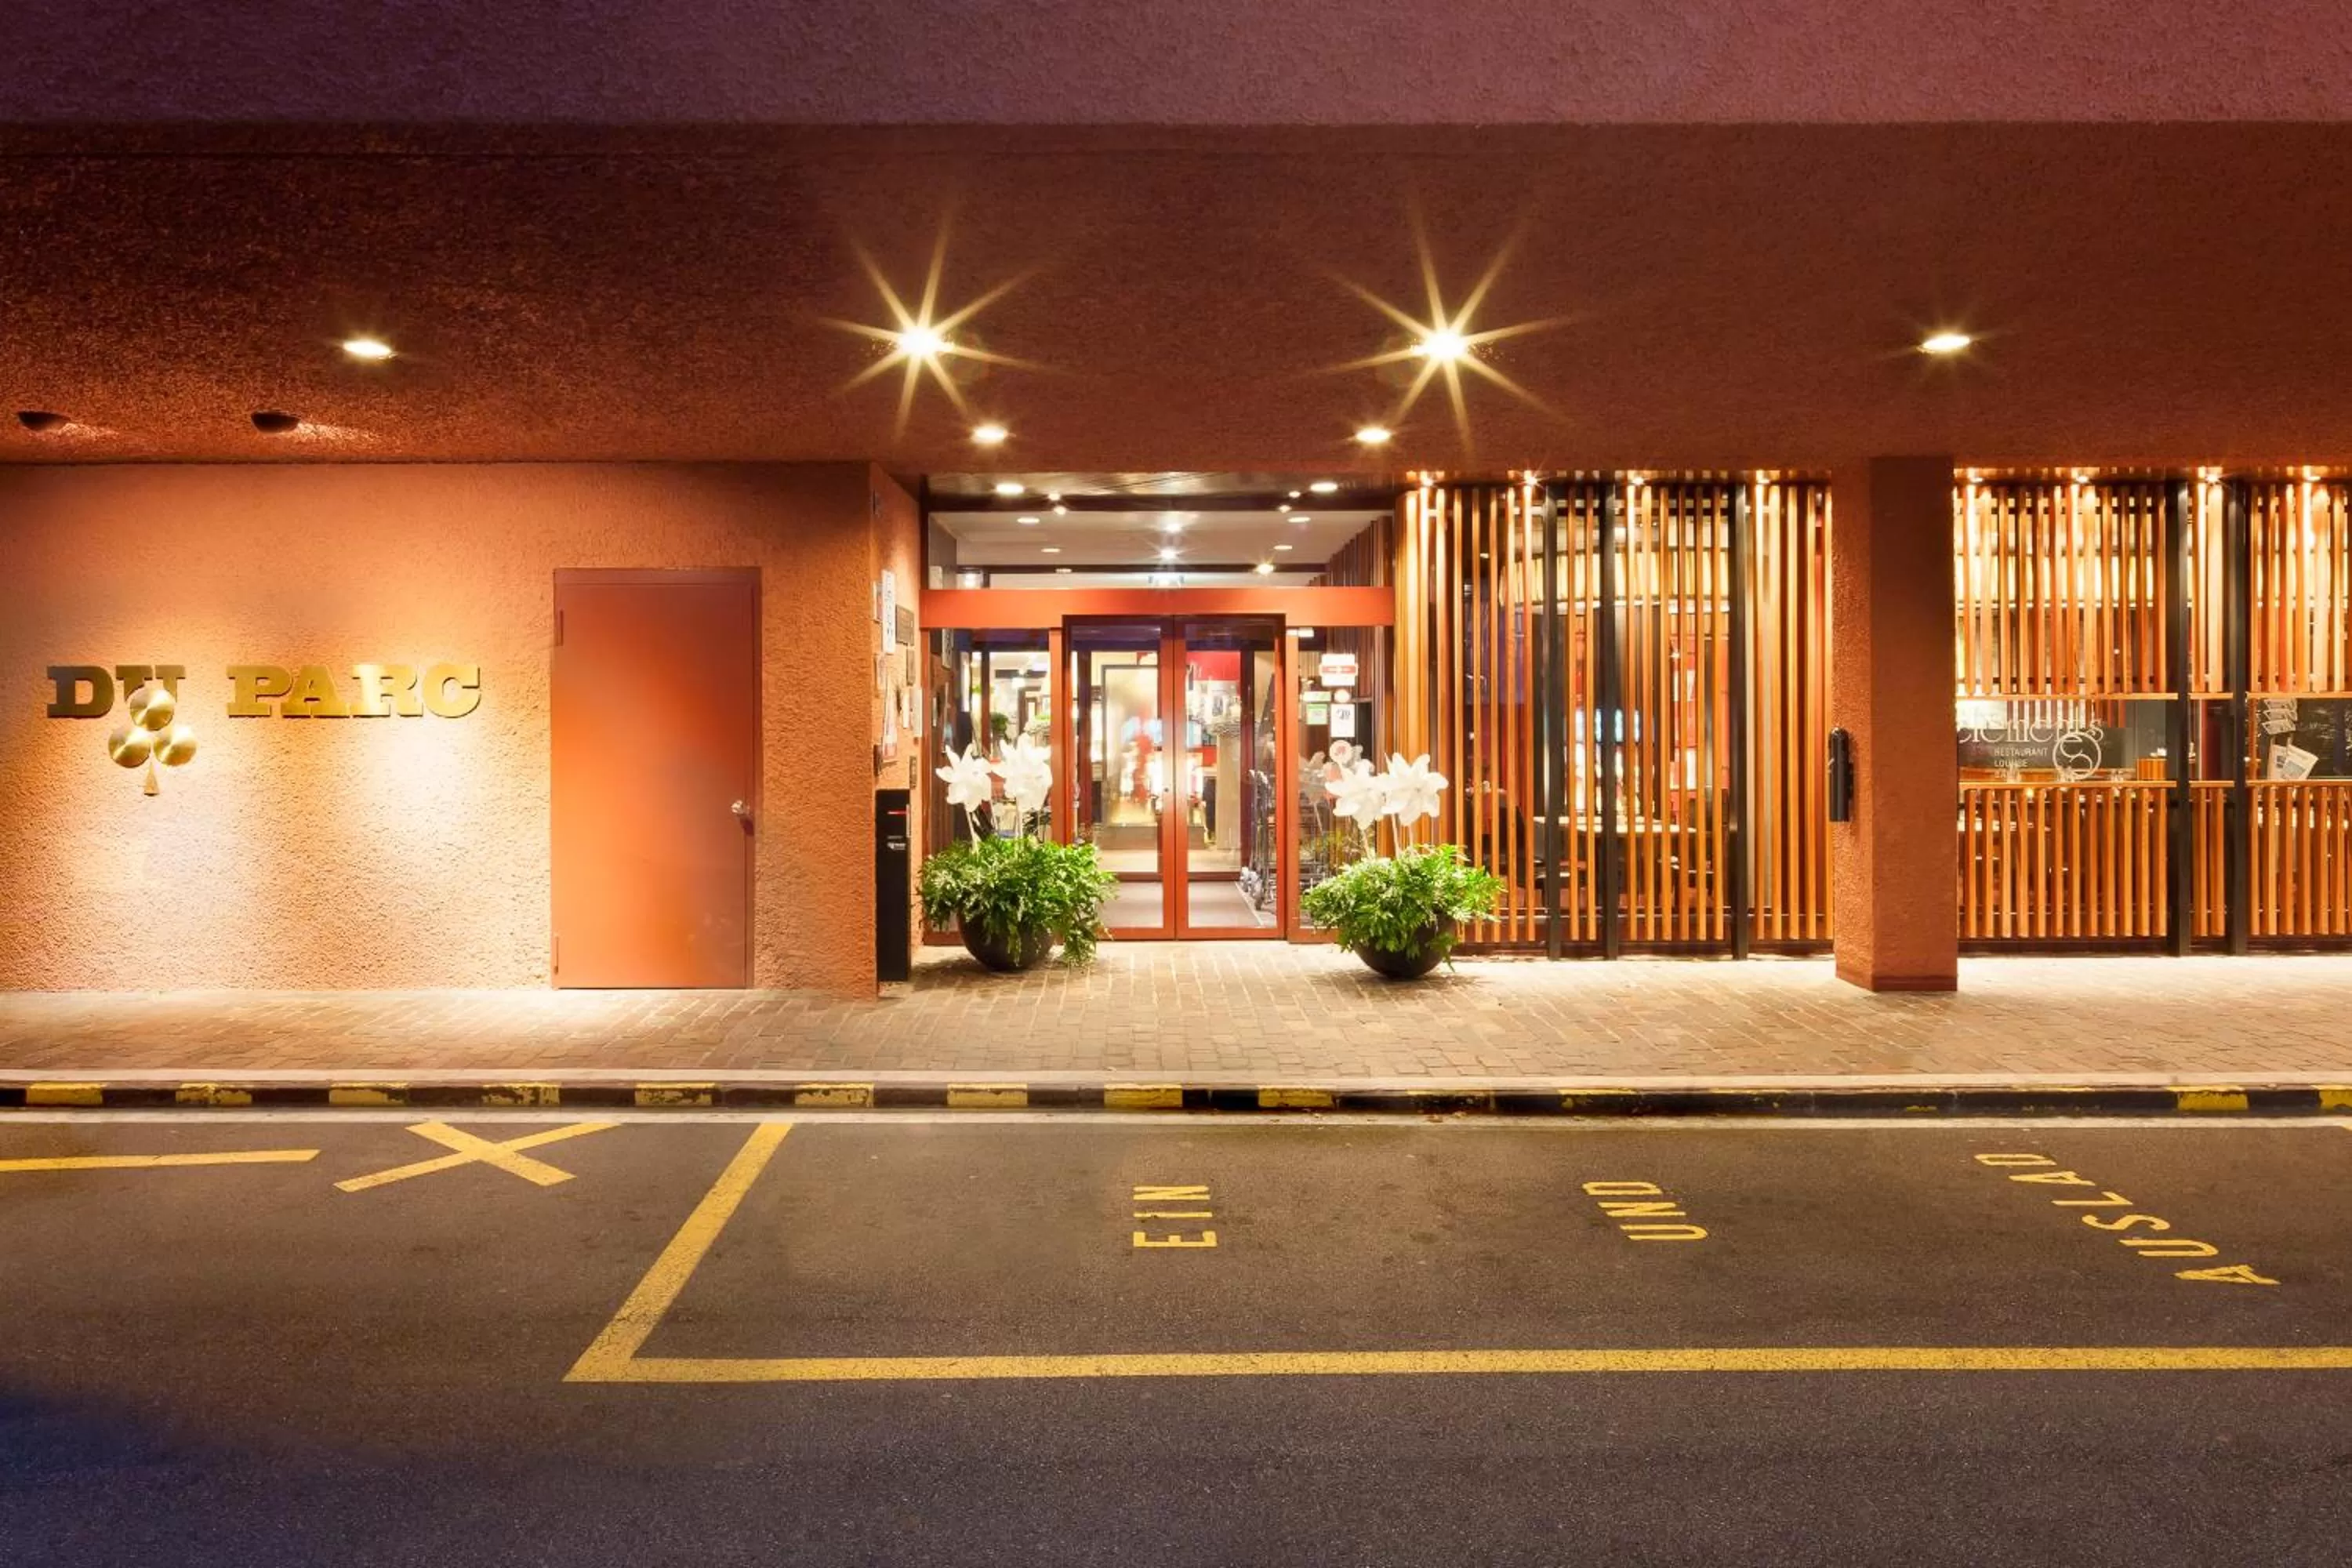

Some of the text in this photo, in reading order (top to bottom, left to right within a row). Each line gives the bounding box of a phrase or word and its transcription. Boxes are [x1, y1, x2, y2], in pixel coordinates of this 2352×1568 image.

[47, 665, 481, 718] DU PARC
[1994, 747, 2049, 757] RESTAURANT
[1133, 1185, 1217, 1247] EIN
[1581, 1181, 1709, 1240] UND
[1973, 1153, 2282, 1285] AUSLAD
